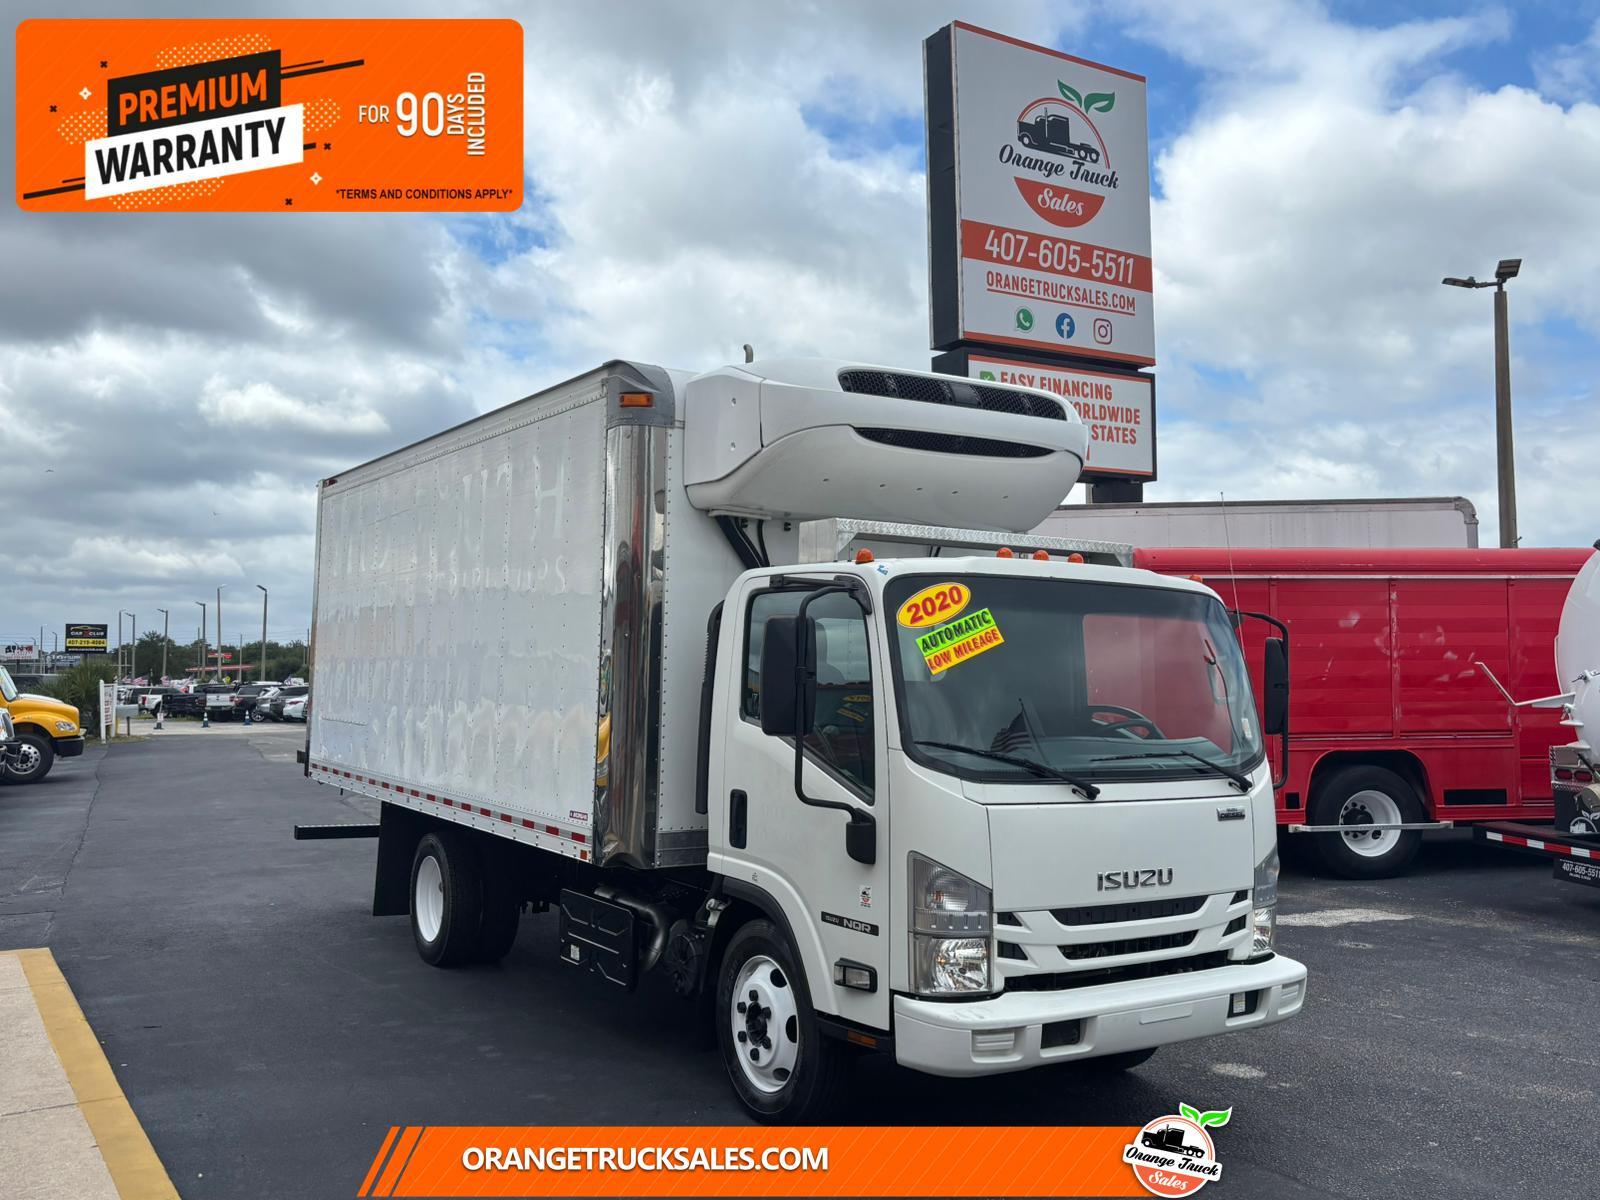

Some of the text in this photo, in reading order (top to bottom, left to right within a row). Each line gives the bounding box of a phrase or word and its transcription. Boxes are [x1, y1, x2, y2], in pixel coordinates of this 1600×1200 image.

[998, 143, 1119, 190] Orange Truck
[1037, 187, 1085, 217] Sales
[984, 228, 1135, 284] 407-605-5511
[985, 269, 1136, 312] ORANGETRUCKSALES.COM
[1039, 376, 1113, 401] FINANCING
[1069, 401, 1141, 425] ORLDWIDE
[1091, 424, 1137, 445] STATES
[906, 585, 963, 625] 2020
[921, 610, 992, 653] AUTOMATIC
[927, 629, 1001, 671] LOW MILEAGE
[1097, 866, 1174, 892] ISUZU
[843, 918, 872, 933] NQR
